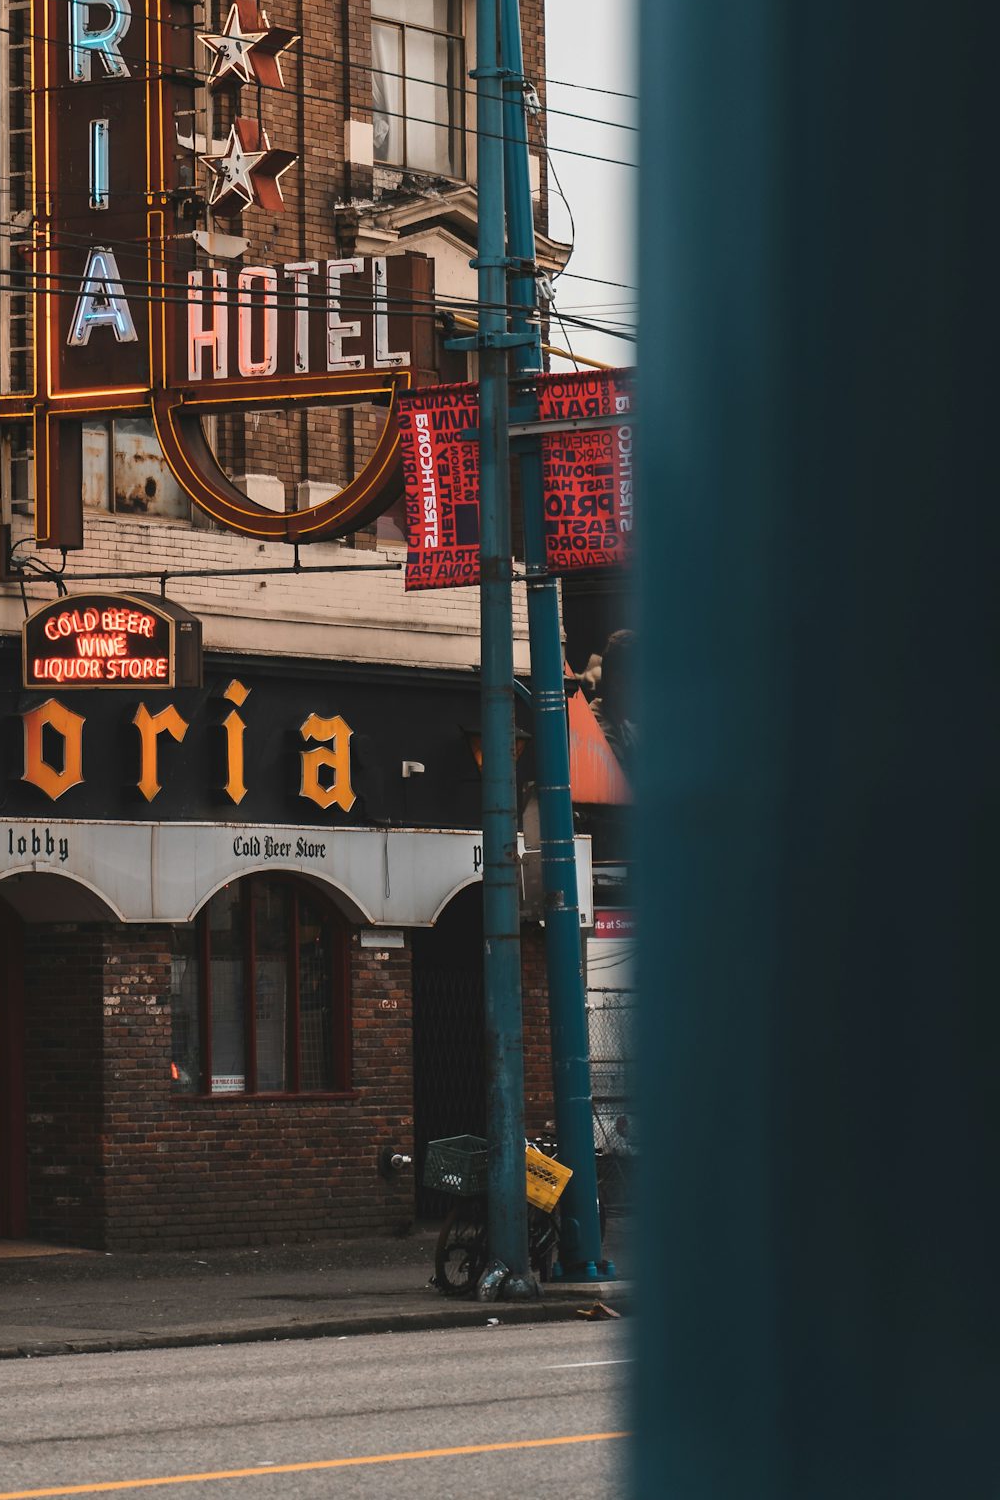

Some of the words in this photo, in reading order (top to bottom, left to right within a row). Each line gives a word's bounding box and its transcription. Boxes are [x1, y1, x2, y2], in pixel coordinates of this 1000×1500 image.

[187, 257, 411, 381] HOTEL
[45, 608, 99, 640] COLD
[102, 608, 156, 637] BEER
[76, 634, 127, 657] WINE
[34, 658, 101, 682] LIQUOR
[106, 658, 168, 679] STORE
[7, 828, 69, 863] lobby
[233, 836, 261, 857] Cold
[264, 835, 291, 859] Beer
[295, 836, 327, 859] Store
